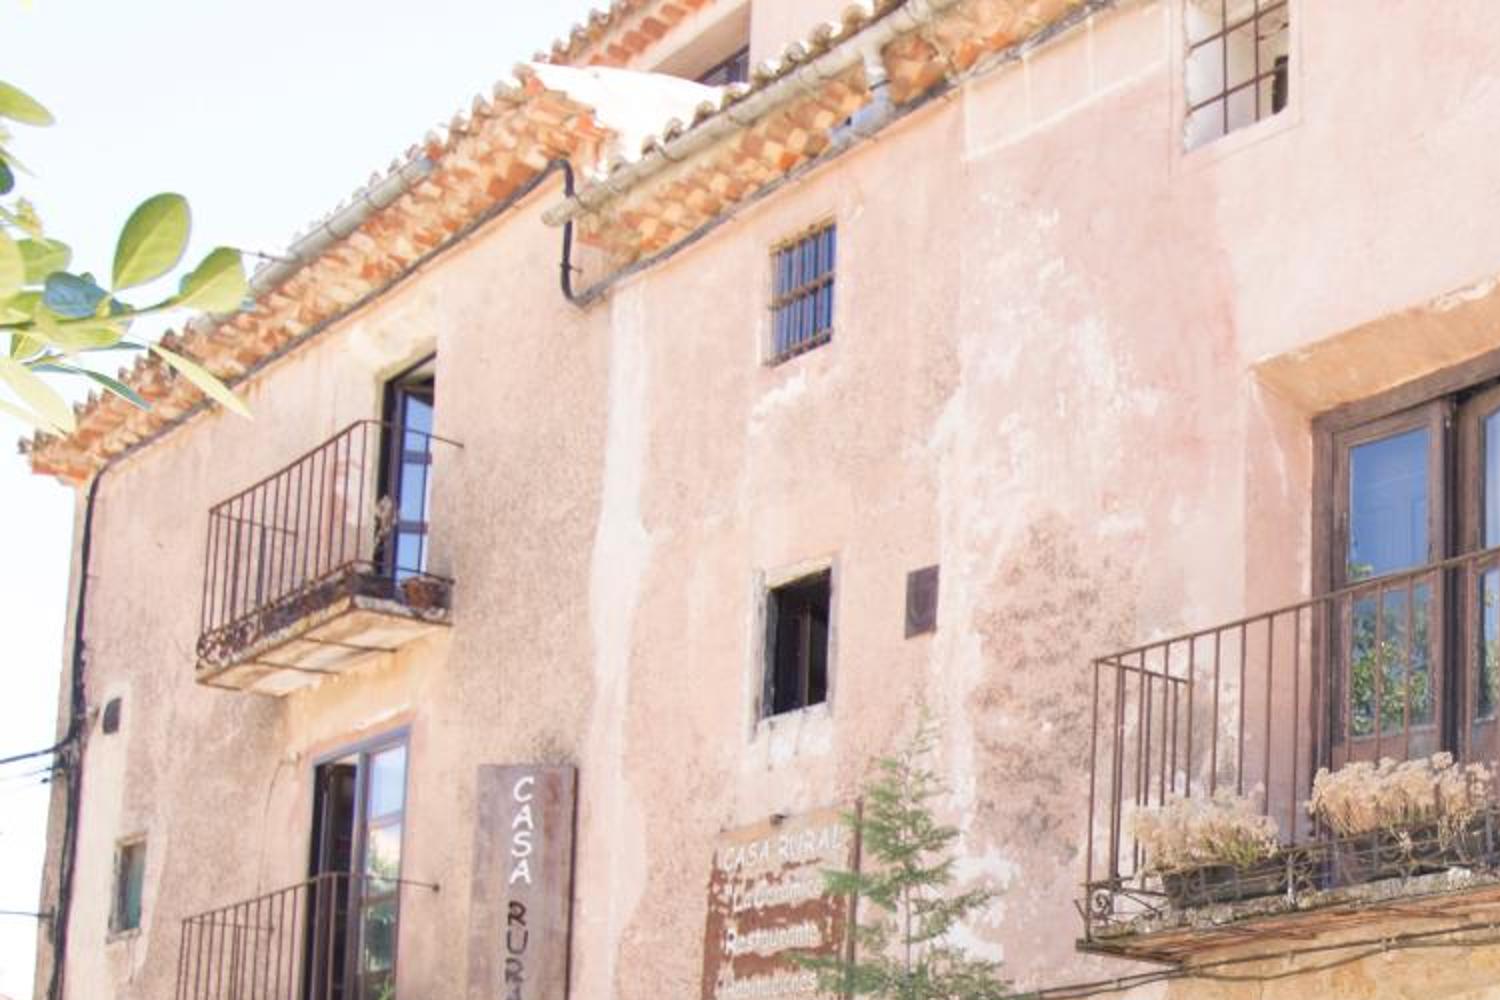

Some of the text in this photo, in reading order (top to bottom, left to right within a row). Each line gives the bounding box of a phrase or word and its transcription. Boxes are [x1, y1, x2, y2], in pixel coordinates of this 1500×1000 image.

[508, 776, 535, 885] CASA
[723, 825, 843, 873] CASA RURAL
